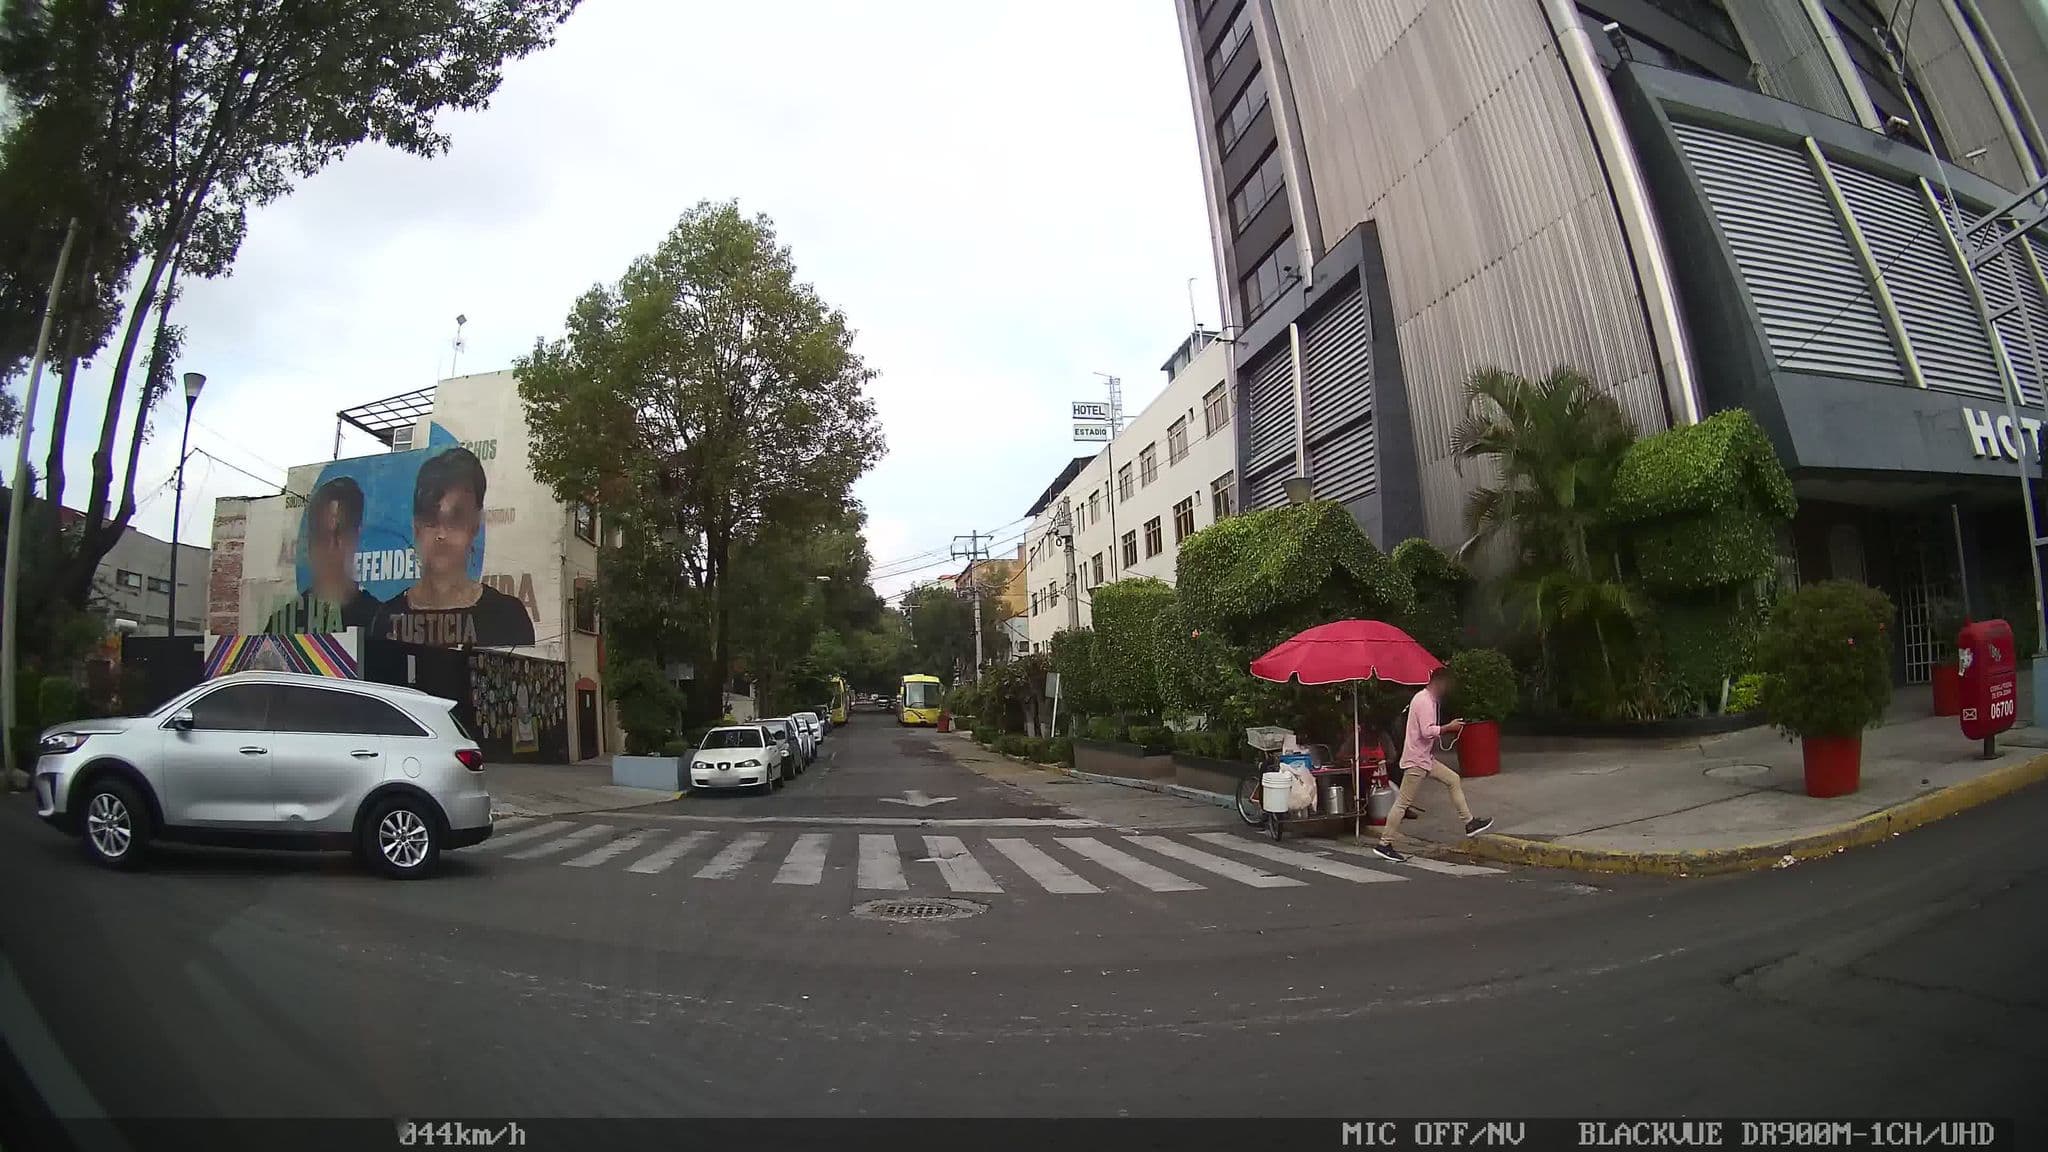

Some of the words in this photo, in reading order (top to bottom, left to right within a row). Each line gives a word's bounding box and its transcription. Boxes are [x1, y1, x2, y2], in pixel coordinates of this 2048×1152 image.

[1073, 405, 1106, 416] HOTEL
[1074, 428, 1107, 436] ESTADIO
[353, 548, 422, 582] EFENDE
[387, 611, 478, 645] JUSTICIA
[1990, 699, 2014, 720] 06700
